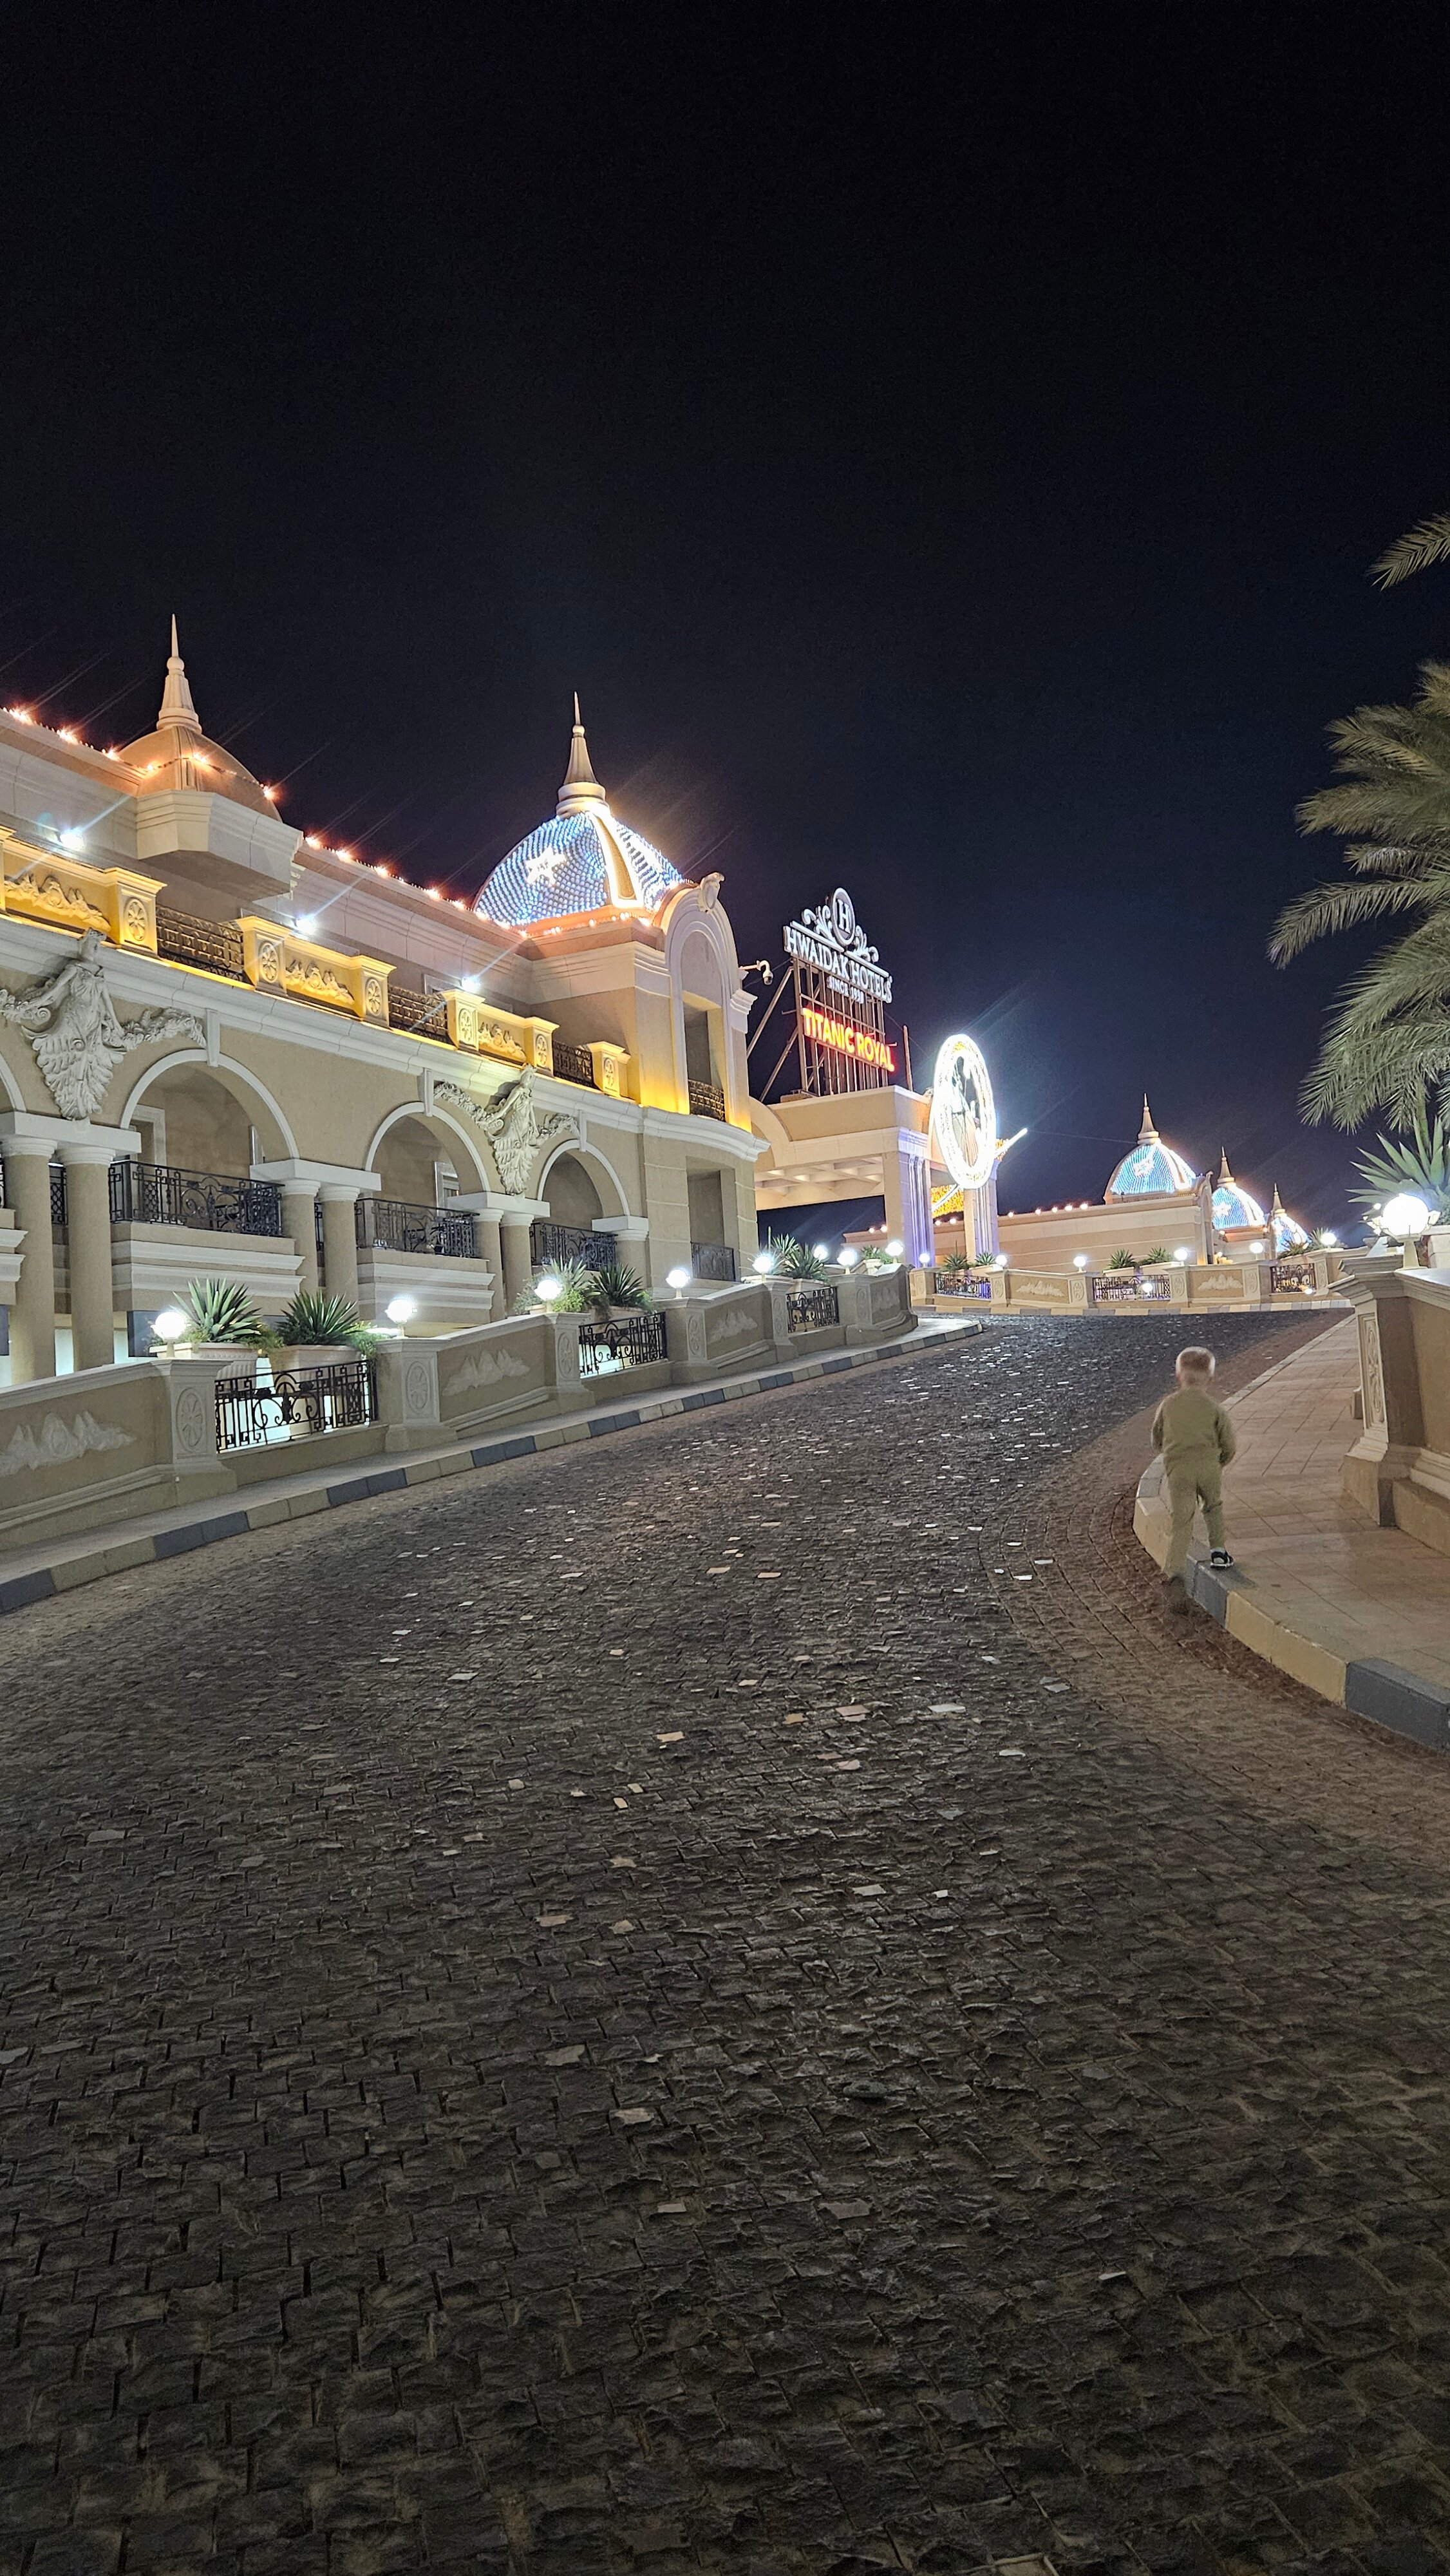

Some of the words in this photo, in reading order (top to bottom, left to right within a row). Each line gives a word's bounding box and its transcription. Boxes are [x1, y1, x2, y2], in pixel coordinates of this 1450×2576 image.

[838, 899, 851, 934] H
[784, 926, 850, 981] HWAIDAK
[849, 960, 892, 1003] HOTELS
[827, 976, 849, 998] SINCE
[802, 1007, 854, 1053] TITANIC
[856, 1031, 894, 1072] ROYAL
